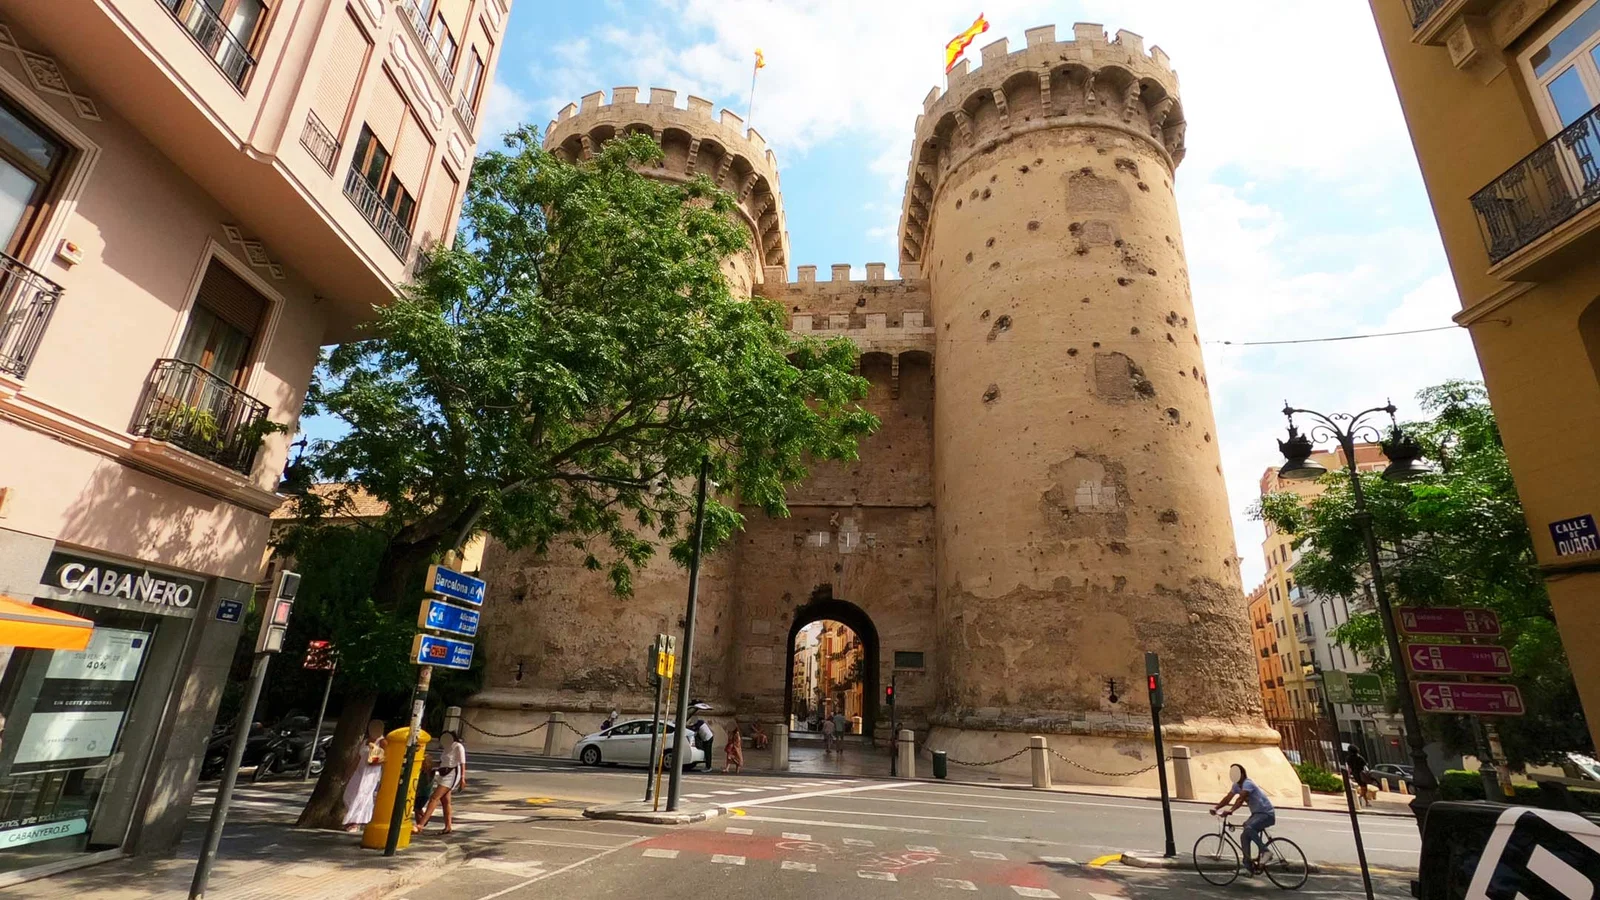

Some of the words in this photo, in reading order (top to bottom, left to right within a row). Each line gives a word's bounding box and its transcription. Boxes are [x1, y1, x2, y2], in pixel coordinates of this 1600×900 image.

[1555, 518, 1588, 534] CALLE
[1569, 530, 1579, 538] DE
[435, 573, 469, 595] Barcelona
[86, 661, 107, 670] 40%
